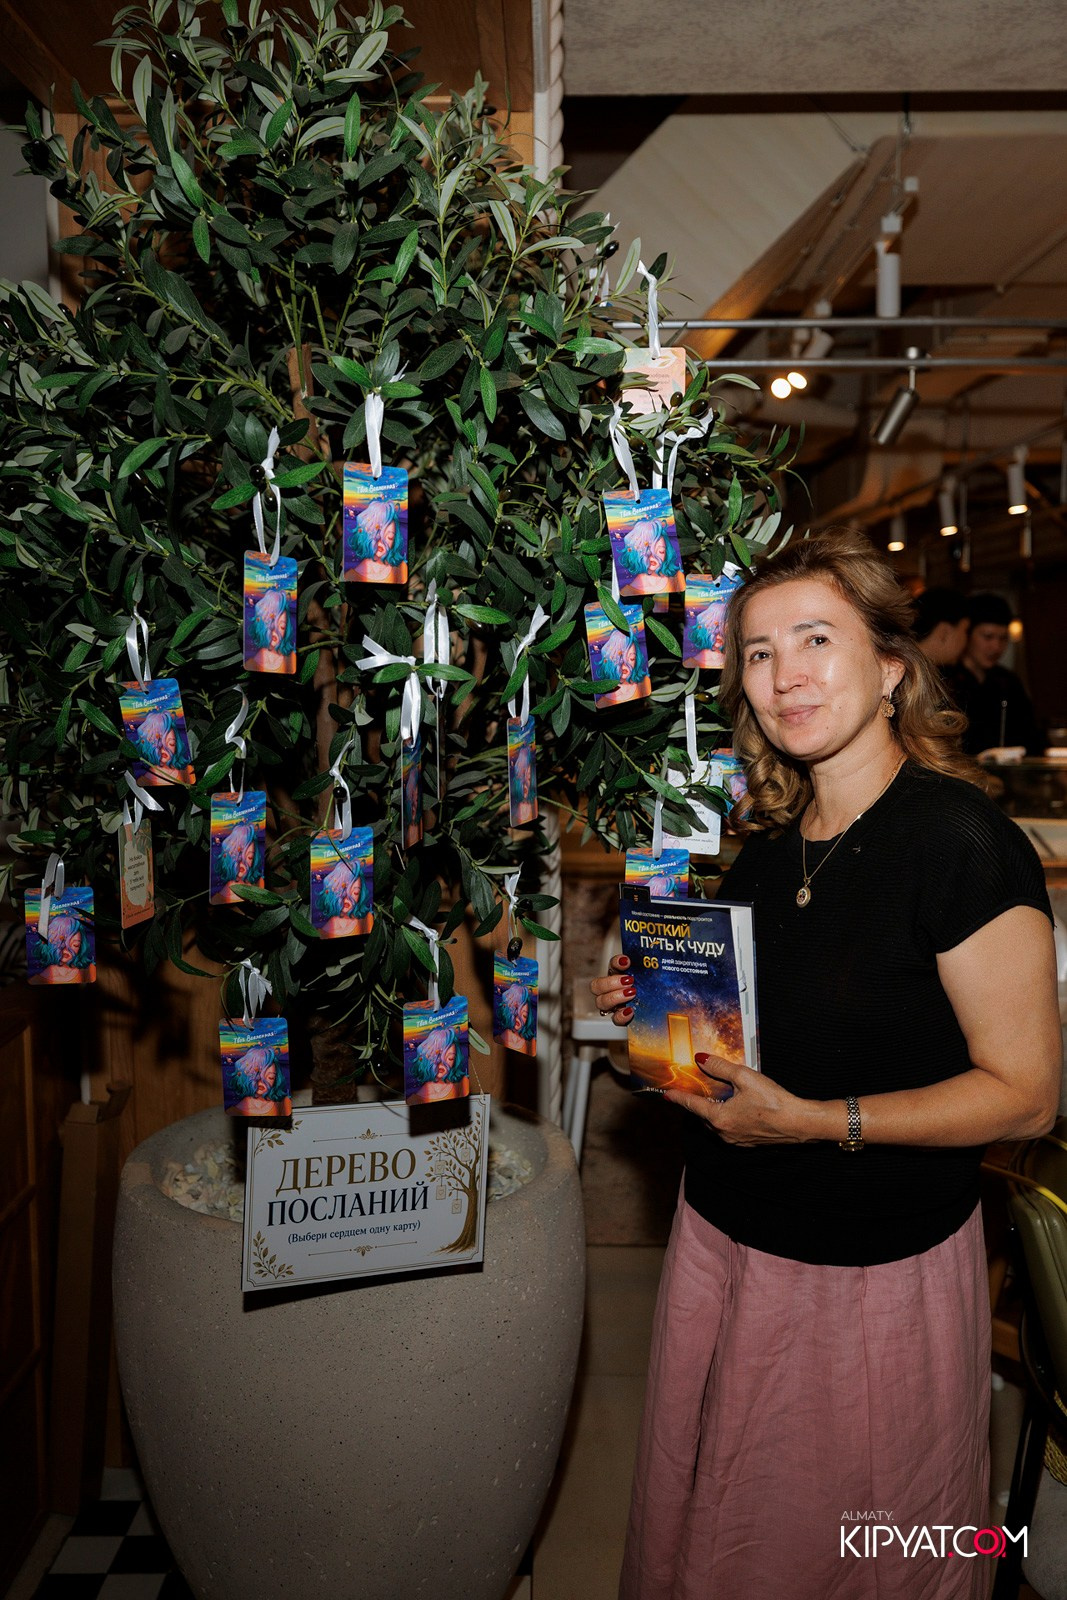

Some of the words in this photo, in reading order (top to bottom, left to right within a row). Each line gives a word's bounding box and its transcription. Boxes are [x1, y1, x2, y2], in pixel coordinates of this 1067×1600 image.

[624, 919, 691, 939] КОРОТКИЙ
[640, 935, 675, 951] ПУТЬ
[675, 939, 686, 953] К
[687, 940, 725, 958] ЧУДУ
[643, 955, 660, 970] 66
[275, 1148, 417, 1198] ДЕРЕВО
[266, 1180, 430, 1227] ПОСЛАНИЙ
[287, 1231, 328, 1245] (Выбери
[329, 1228, 367, 1240] сердцем
[369, 1225, 391, 1235] одну
[393, 1219, 421, 1232] карту)
